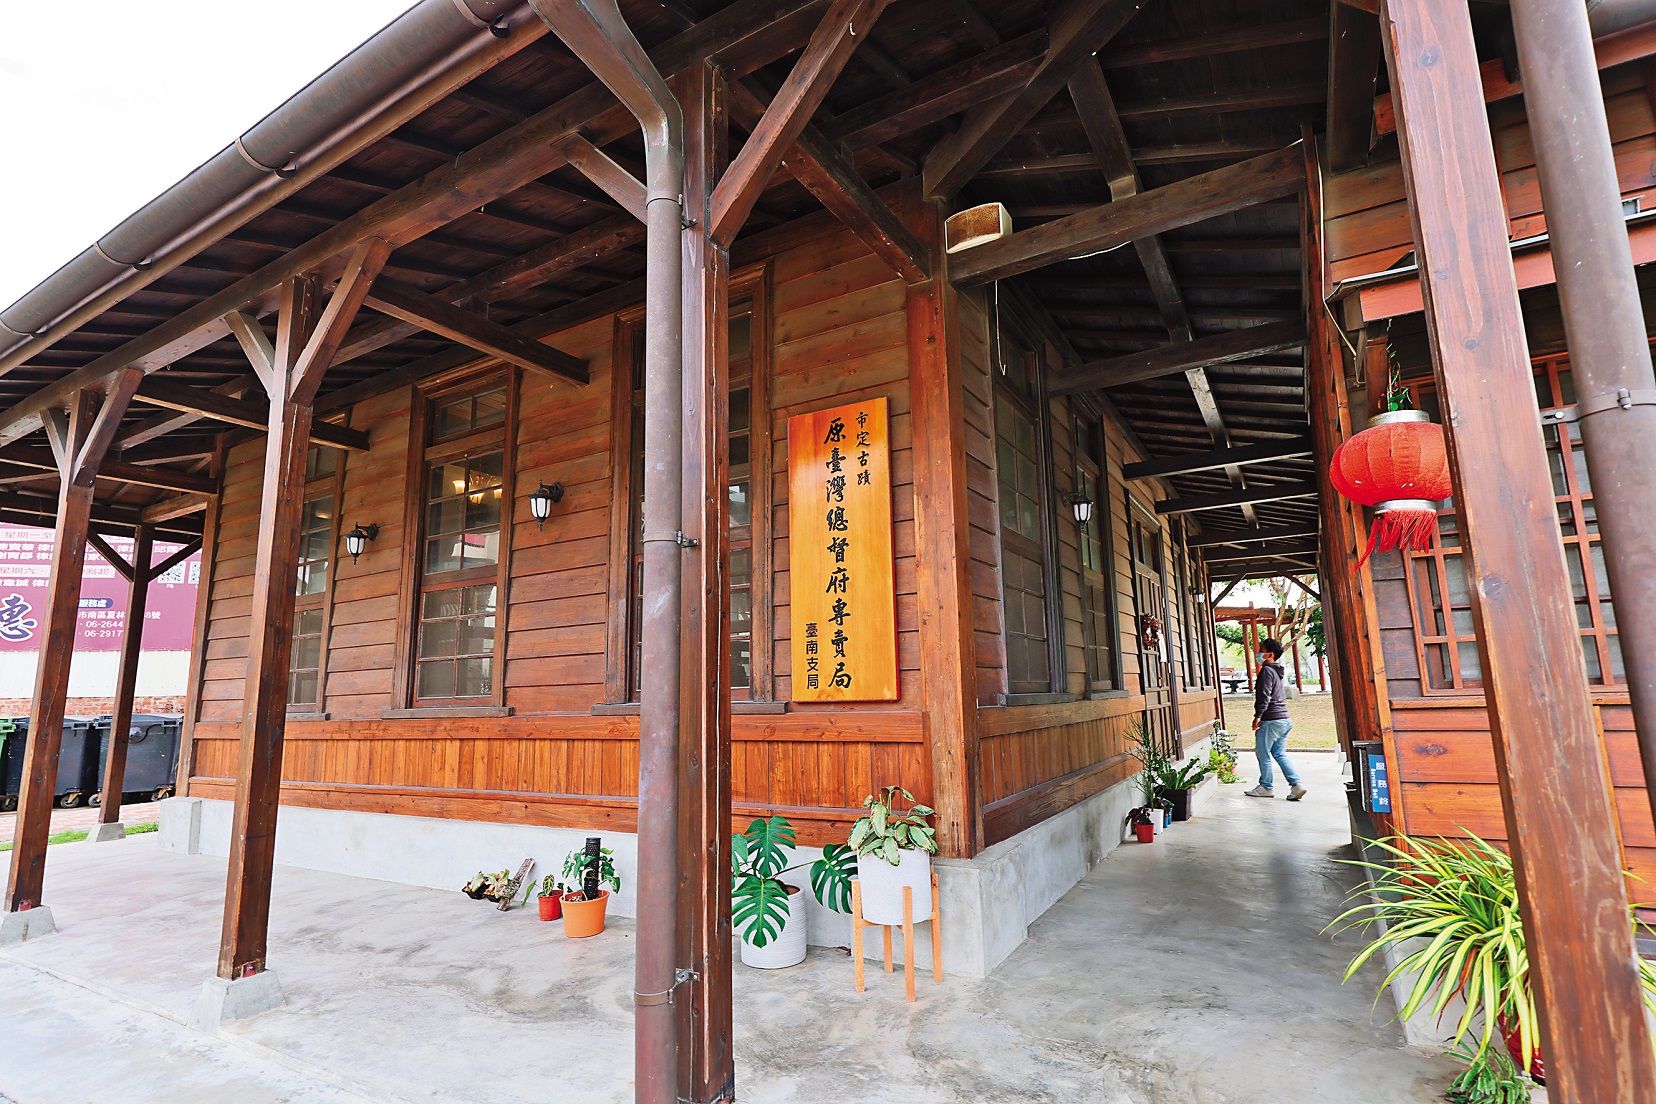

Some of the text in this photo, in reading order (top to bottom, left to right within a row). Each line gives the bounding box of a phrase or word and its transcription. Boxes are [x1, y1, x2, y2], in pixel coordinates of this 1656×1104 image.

[855, 411, 871, 486] 市定古蹟
[144, 611, 161, 619] 8號
[805, 622, 819, 690] 臺南支局
